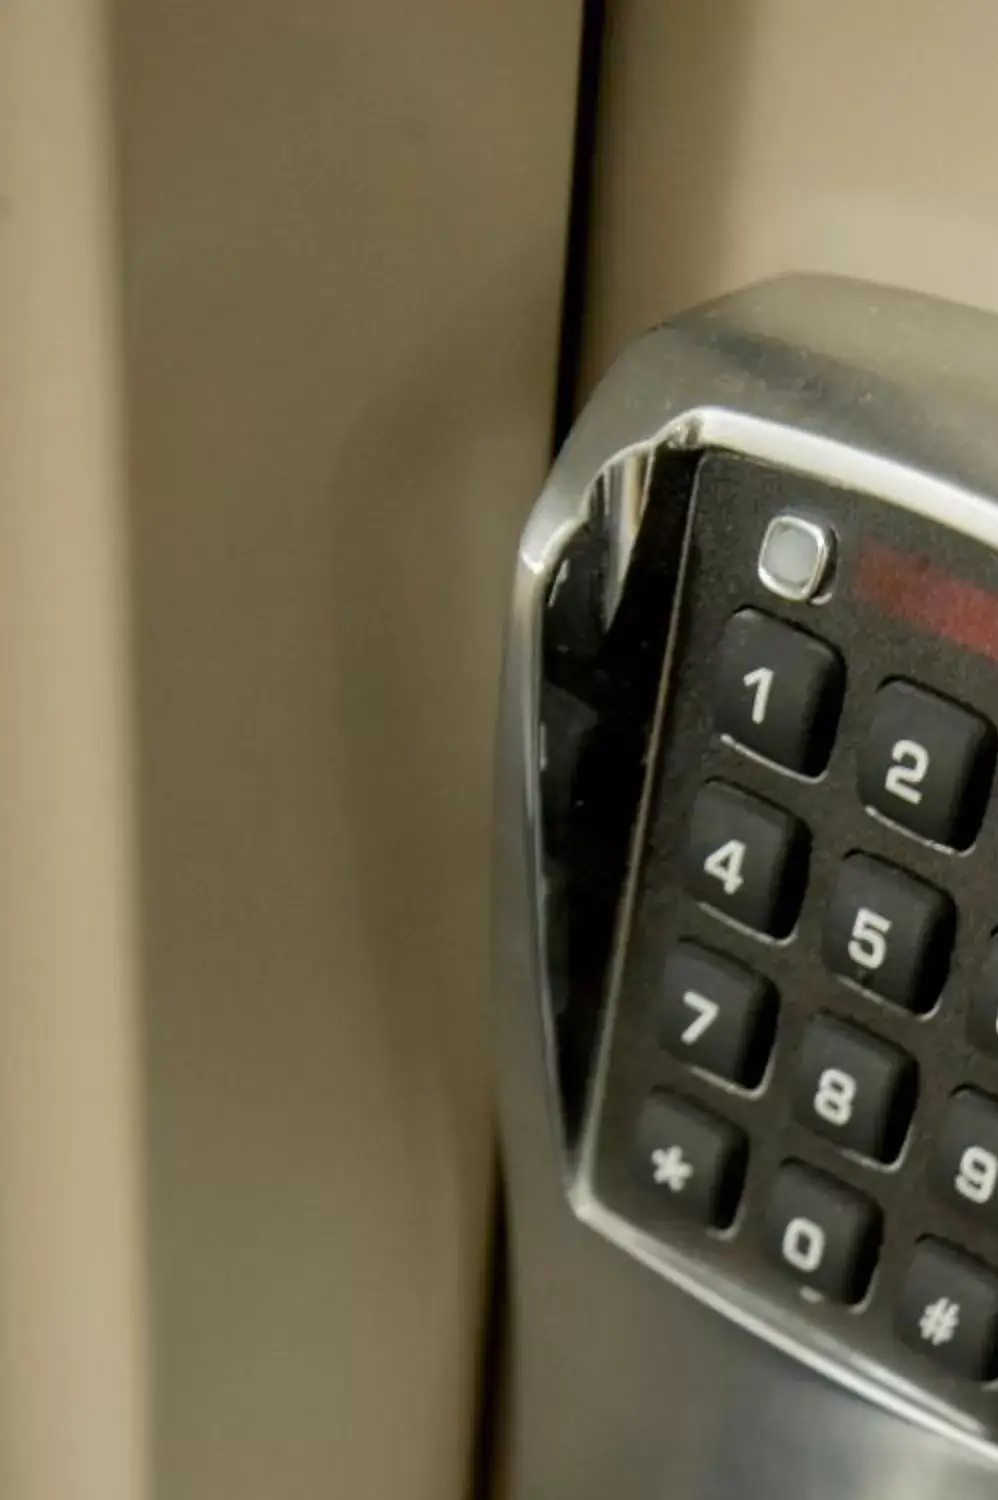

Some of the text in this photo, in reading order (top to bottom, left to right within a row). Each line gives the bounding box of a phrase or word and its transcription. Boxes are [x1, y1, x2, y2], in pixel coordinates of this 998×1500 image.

[743, 666, 774, 724] 1
[885, 739, 930, 804] 2
[704, 839, 746, 894] 4
[847, 907, 892, 969] 5
[681, 991, 720, 1044] 7
[814, 1068, 857, 1126] 8
[782, 1217, 825, 1272] 0
[919, 1297, 960, 1346] #
